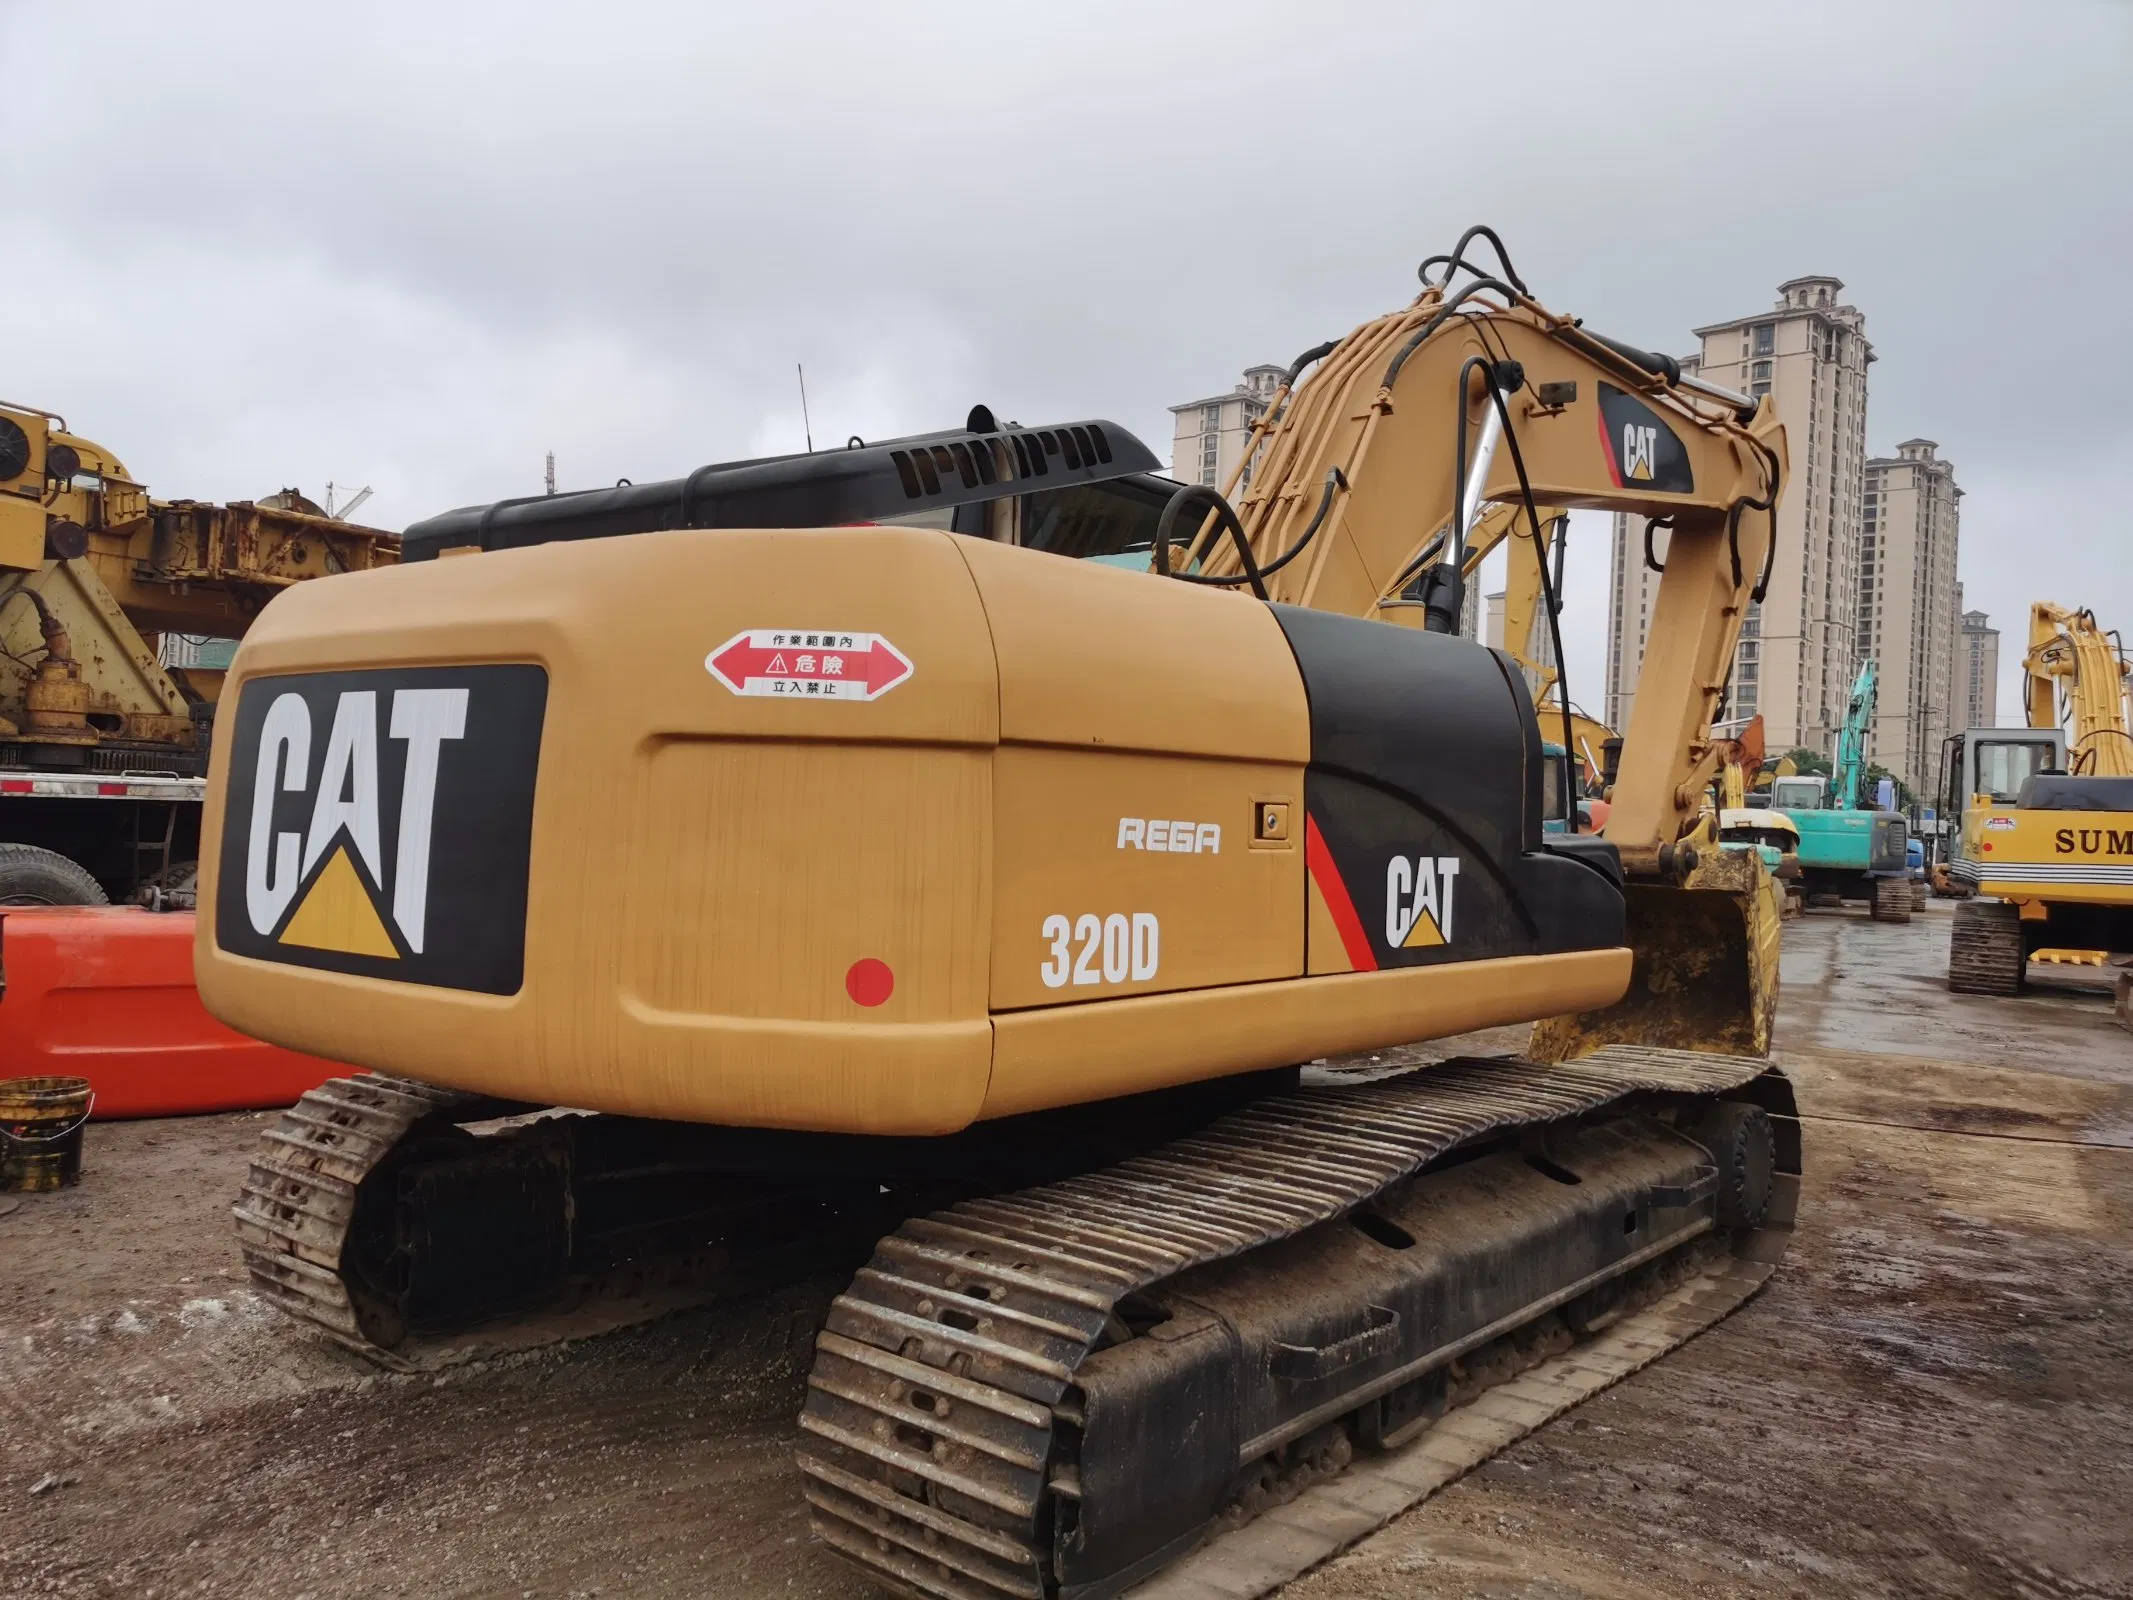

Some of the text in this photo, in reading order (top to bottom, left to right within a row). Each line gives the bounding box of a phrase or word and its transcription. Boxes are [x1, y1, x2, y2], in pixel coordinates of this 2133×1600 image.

[1623, 422, 1657, 480] CAT
[772, 680, 837, 695] 立入禁止
[245, 688, 470, 955] CAT
[1116, 817, 1222, 855] REGA
[1385, 854, 1460, 949] CAT
[1040, 912, 1159, 989] 320D
